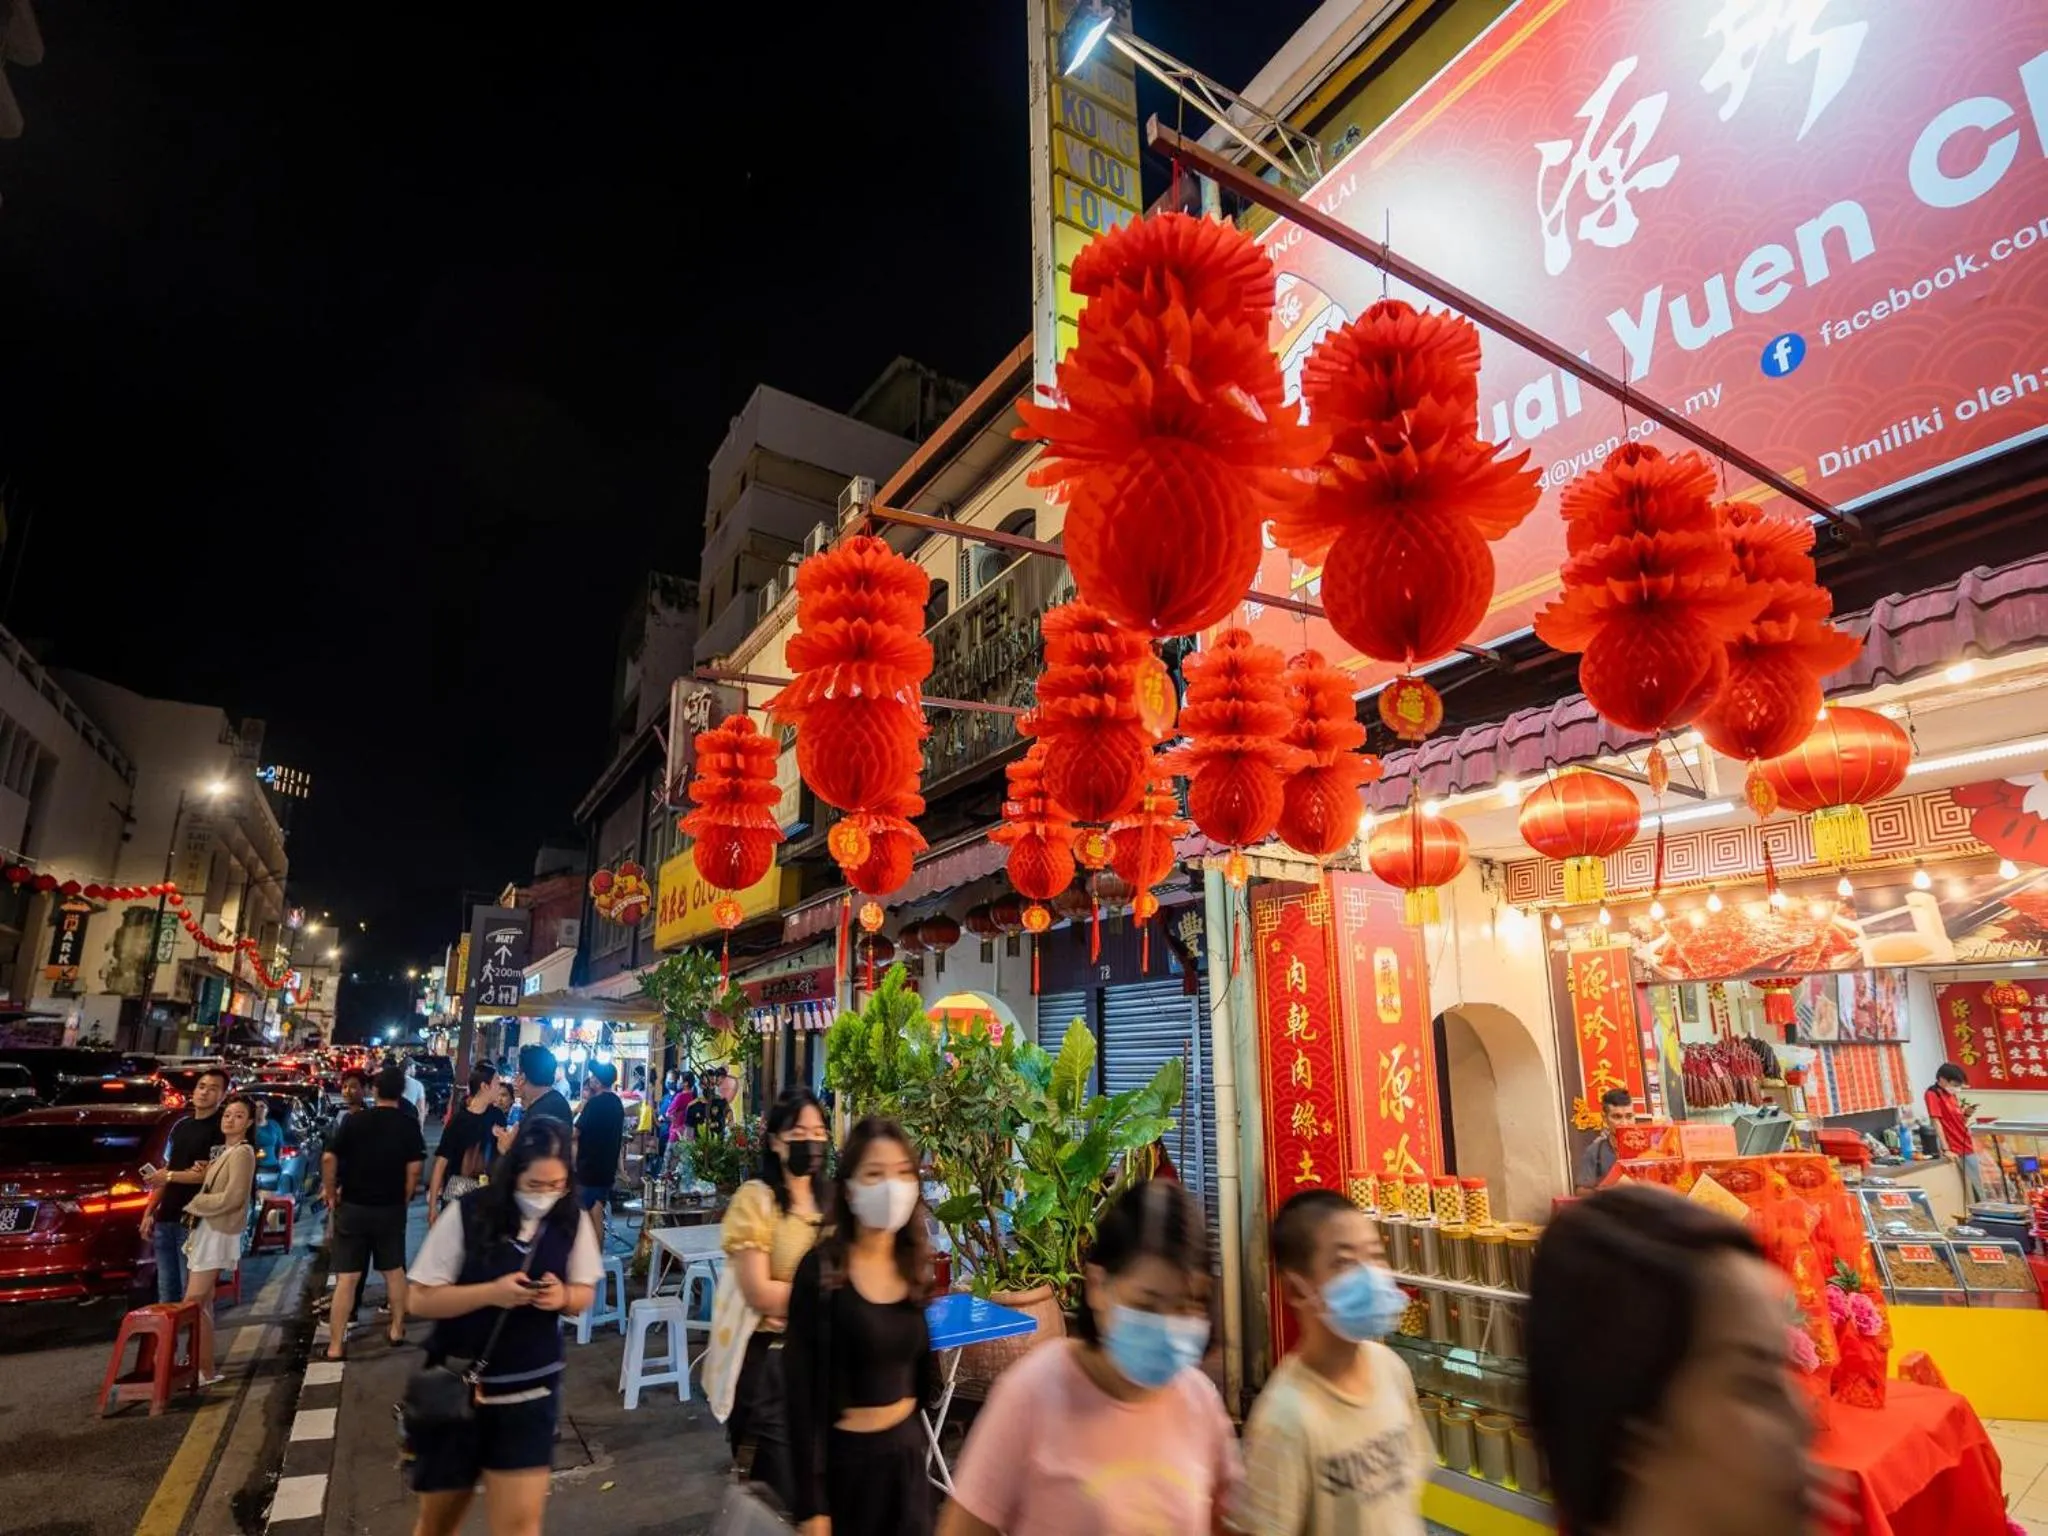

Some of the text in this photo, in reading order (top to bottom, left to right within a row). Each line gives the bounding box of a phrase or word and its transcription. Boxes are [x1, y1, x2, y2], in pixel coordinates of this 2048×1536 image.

[1062, 86, 1135, 158] KONG
[1317, 173, 1358, 215] ALAI
[1606, 200, 1876, 384] Yuen
[1820, 217, 2048, 347] facebook.co
[1818, 406, 1944, 478] Dimiliki
[57, 918, 79, 965] PARK
[495, 934, 515, 944] MRT
[494, 967, 521, 978] 200m
